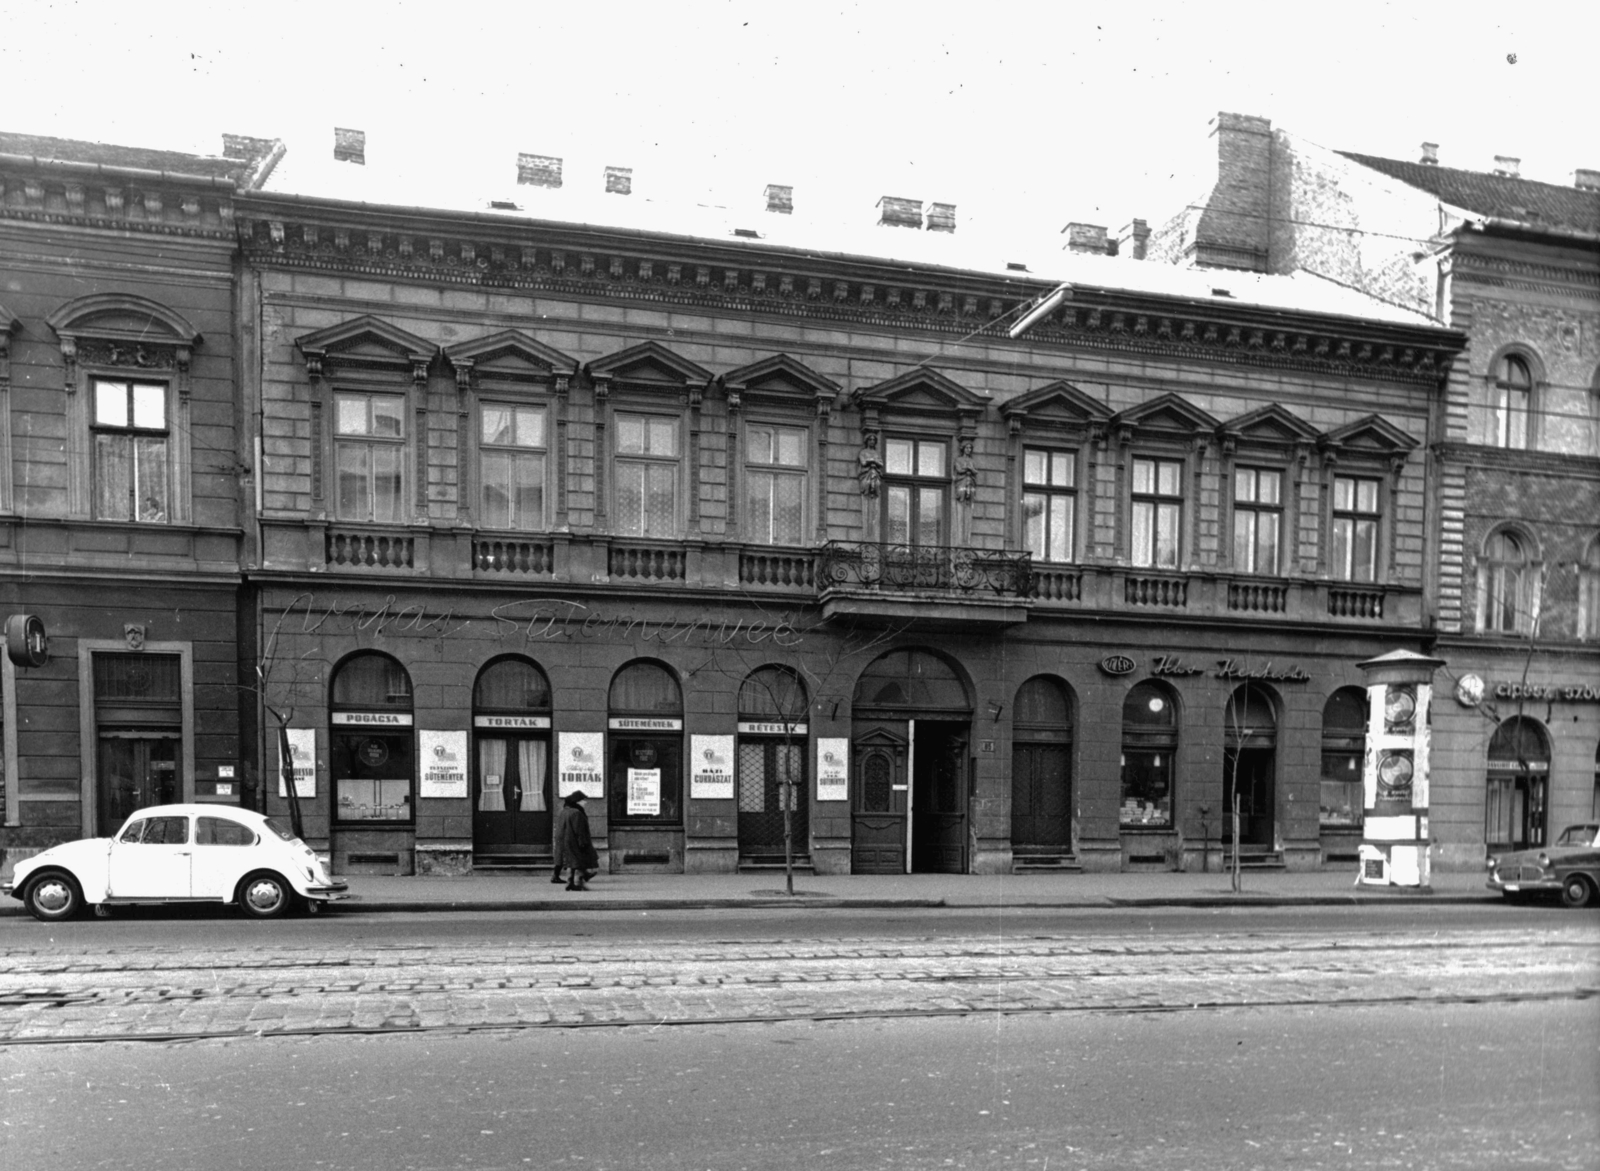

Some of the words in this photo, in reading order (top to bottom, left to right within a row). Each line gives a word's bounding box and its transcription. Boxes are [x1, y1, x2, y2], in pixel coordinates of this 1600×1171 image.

[346, 713, 400, 723] POGÁCSA
[487, 717, 538, 726] TORTÁK
[618, 719, 674, 728] SÜTEMÉNYEK
[424, 772, 464, 781] SÜTEMÉNYEK
[561, 772, 602, 782] TORTÁK
